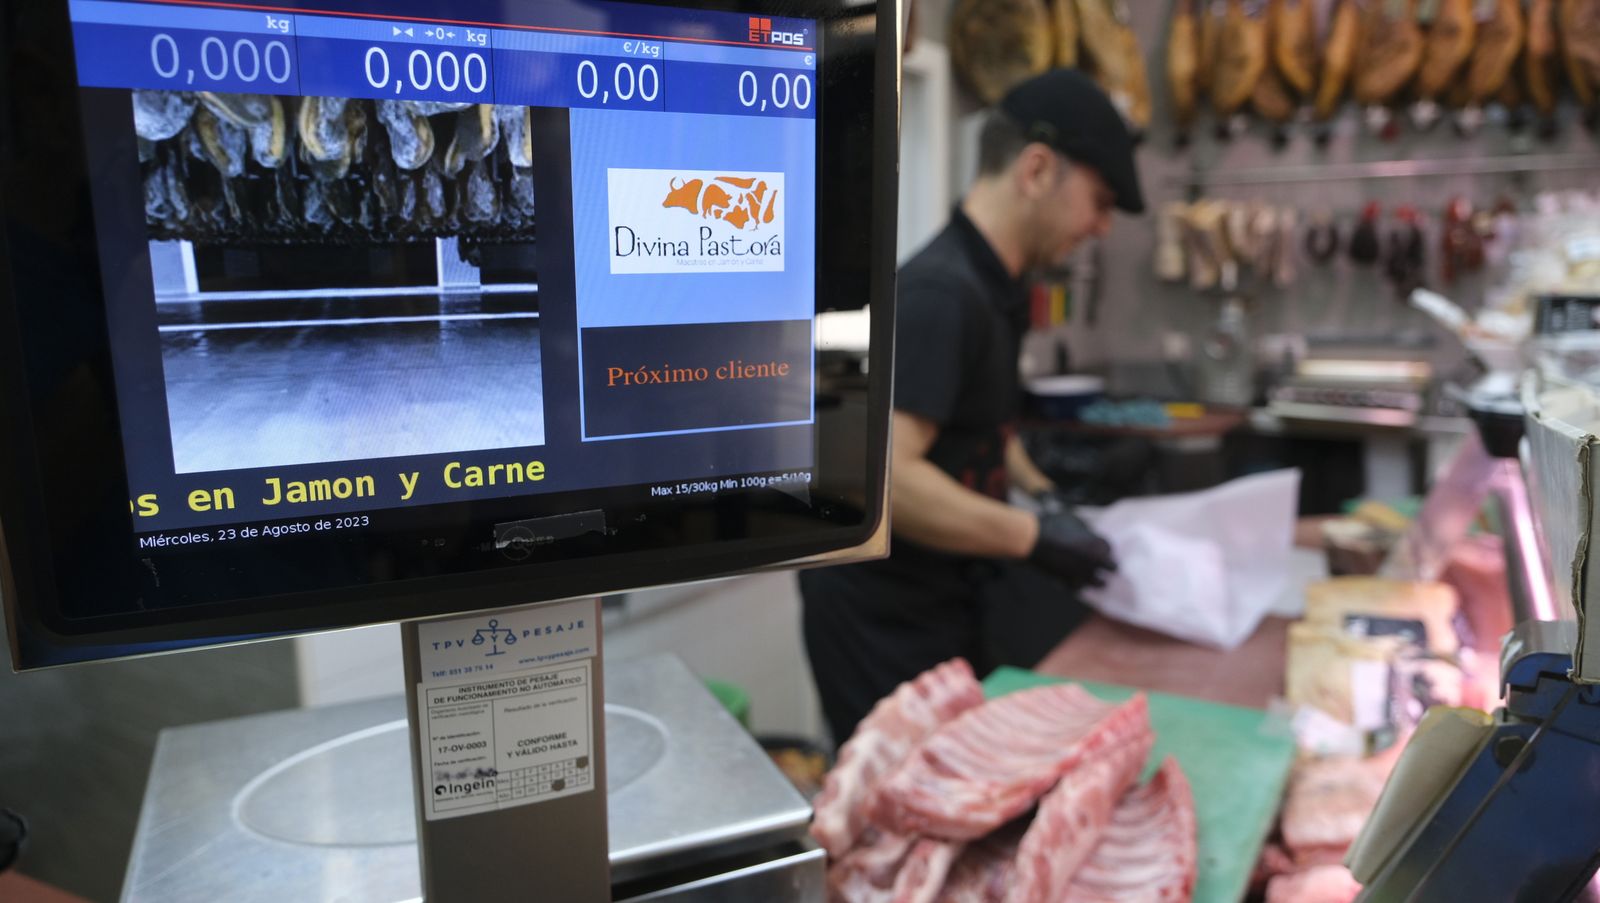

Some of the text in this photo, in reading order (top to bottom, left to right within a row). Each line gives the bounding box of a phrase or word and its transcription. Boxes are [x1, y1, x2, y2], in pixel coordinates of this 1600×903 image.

[266, 15, 291, 33] kg
[466, 29, 488, 46] kg
[622, 41, 660, 58] €/kg
[150, 33, 292, 85] 0,000
[364, 46, 488, 95] 0,000
[804, 55, 813, 66] €
[576, 60, 660, 104] 0,00
[738, 70, 812, 112] 0,00
[614, 226, 690, 257] Divina
[607, 360, 790, 387] Próximo cliente
[129, 459, 546, 517] s en Jamon y Carne
[651, 486, 673, 497] Max
[675, 481, 718, 496] 15/30kg
[719, 478, 738, 490] Min
[740, 476, 766, 489] 100g
[139, 515, 370, 549] Miércoles, 23 de Agosto de 2023
[432, 639, 465, 651] TPV
[522, 620, 585, 639] PESAJE
[433, 676, 582, 705] DE FUNCIONAMIENTO NO AUTOMÁTICO
[458, 673, 559, 694] INSTRUMENTO DE PESAJE
[438, 740, 488, 754] 17-OV-0003
[514, 744, 549, 758] VÁLIDO
[549, 739, 578, 751] HASTA
[517, 732, 568, 748] CONFORME
[449, 777, 496, 794] Ingein
